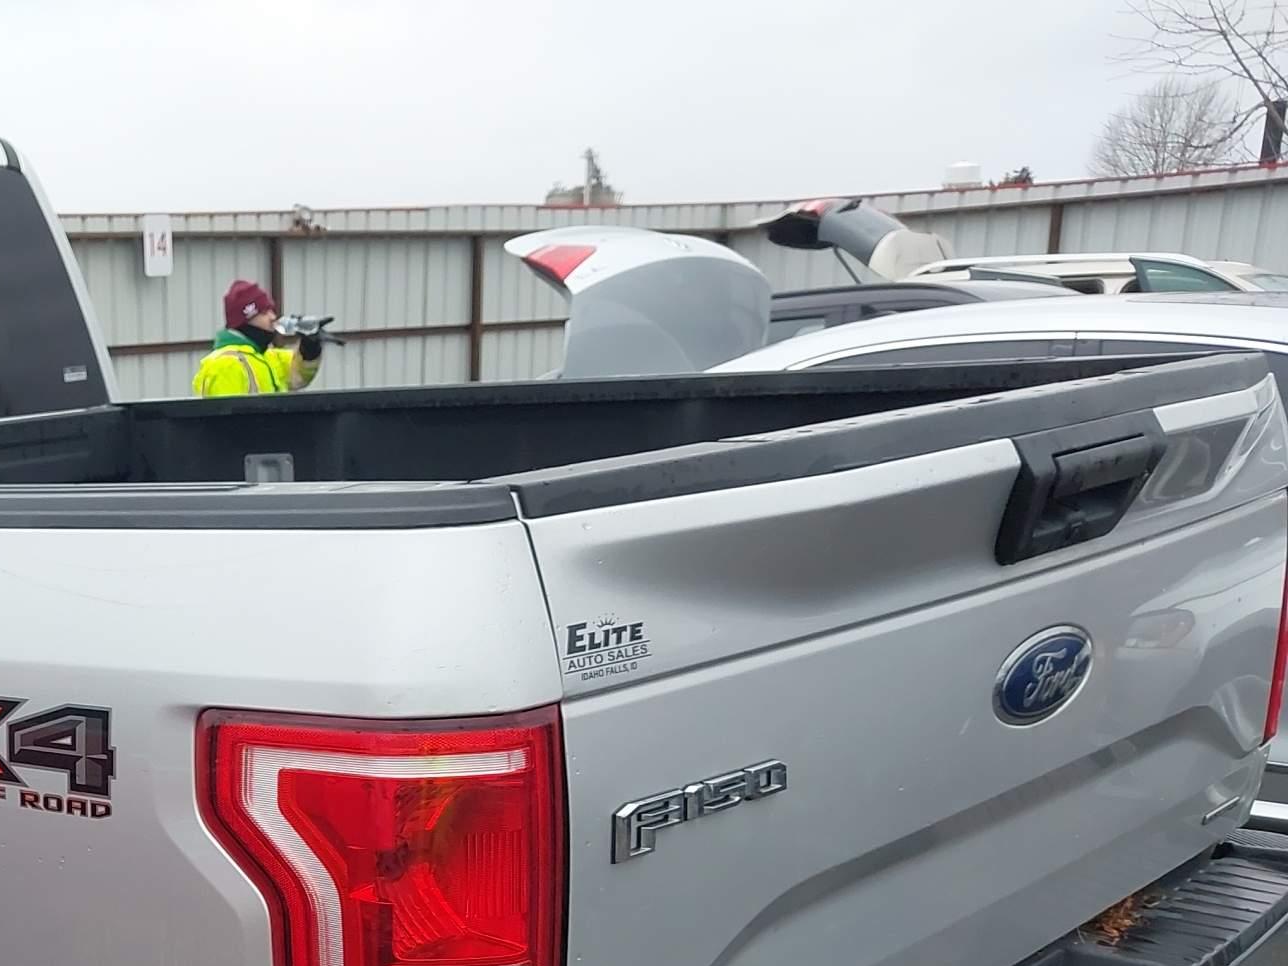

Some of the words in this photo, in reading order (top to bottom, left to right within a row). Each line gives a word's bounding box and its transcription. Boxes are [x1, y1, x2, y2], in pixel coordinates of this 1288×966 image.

[148, 231, 168, 257] 14
[567, 653, 604, 671] AUTO
[607, 643, 648, 662] SALES
[581, 669, 604, 681] IDAHO
[1023, 647, 1084, 708] Ford
[19, 788, 113, 819] ROAD
[611, 758, 787, 864] F150
